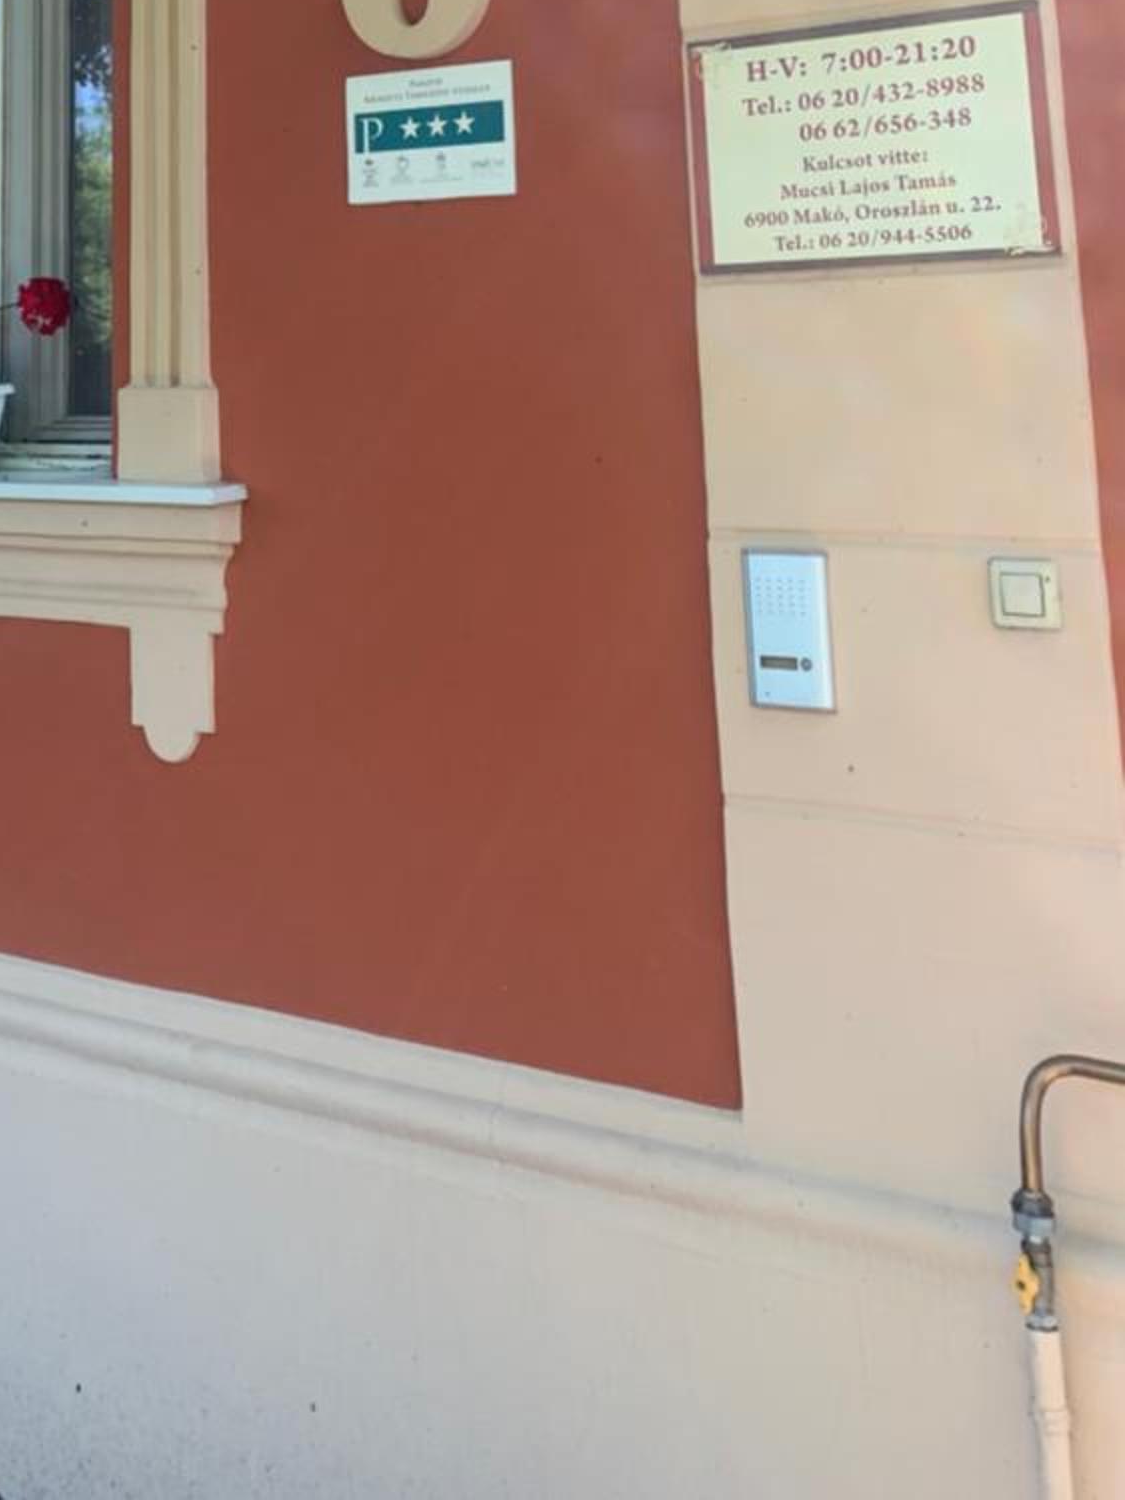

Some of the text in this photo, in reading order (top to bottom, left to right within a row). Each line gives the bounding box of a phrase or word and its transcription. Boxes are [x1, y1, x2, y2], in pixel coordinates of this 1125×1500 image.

[745, 35, 977, 82] H-V: 7:00-21:20
[742, 95, 792, 117] Tel.:
[797, 91, 825, 111] 06
[799, 122, 827, 141] 06
[840, 179, 891, 199] Lajos
[894, 170, 957, 192] Tamás
[743, 211, 789, 229] 6900
[774, 234, 814, 252] Tel.:
[819, 232, 842, 249] 06
